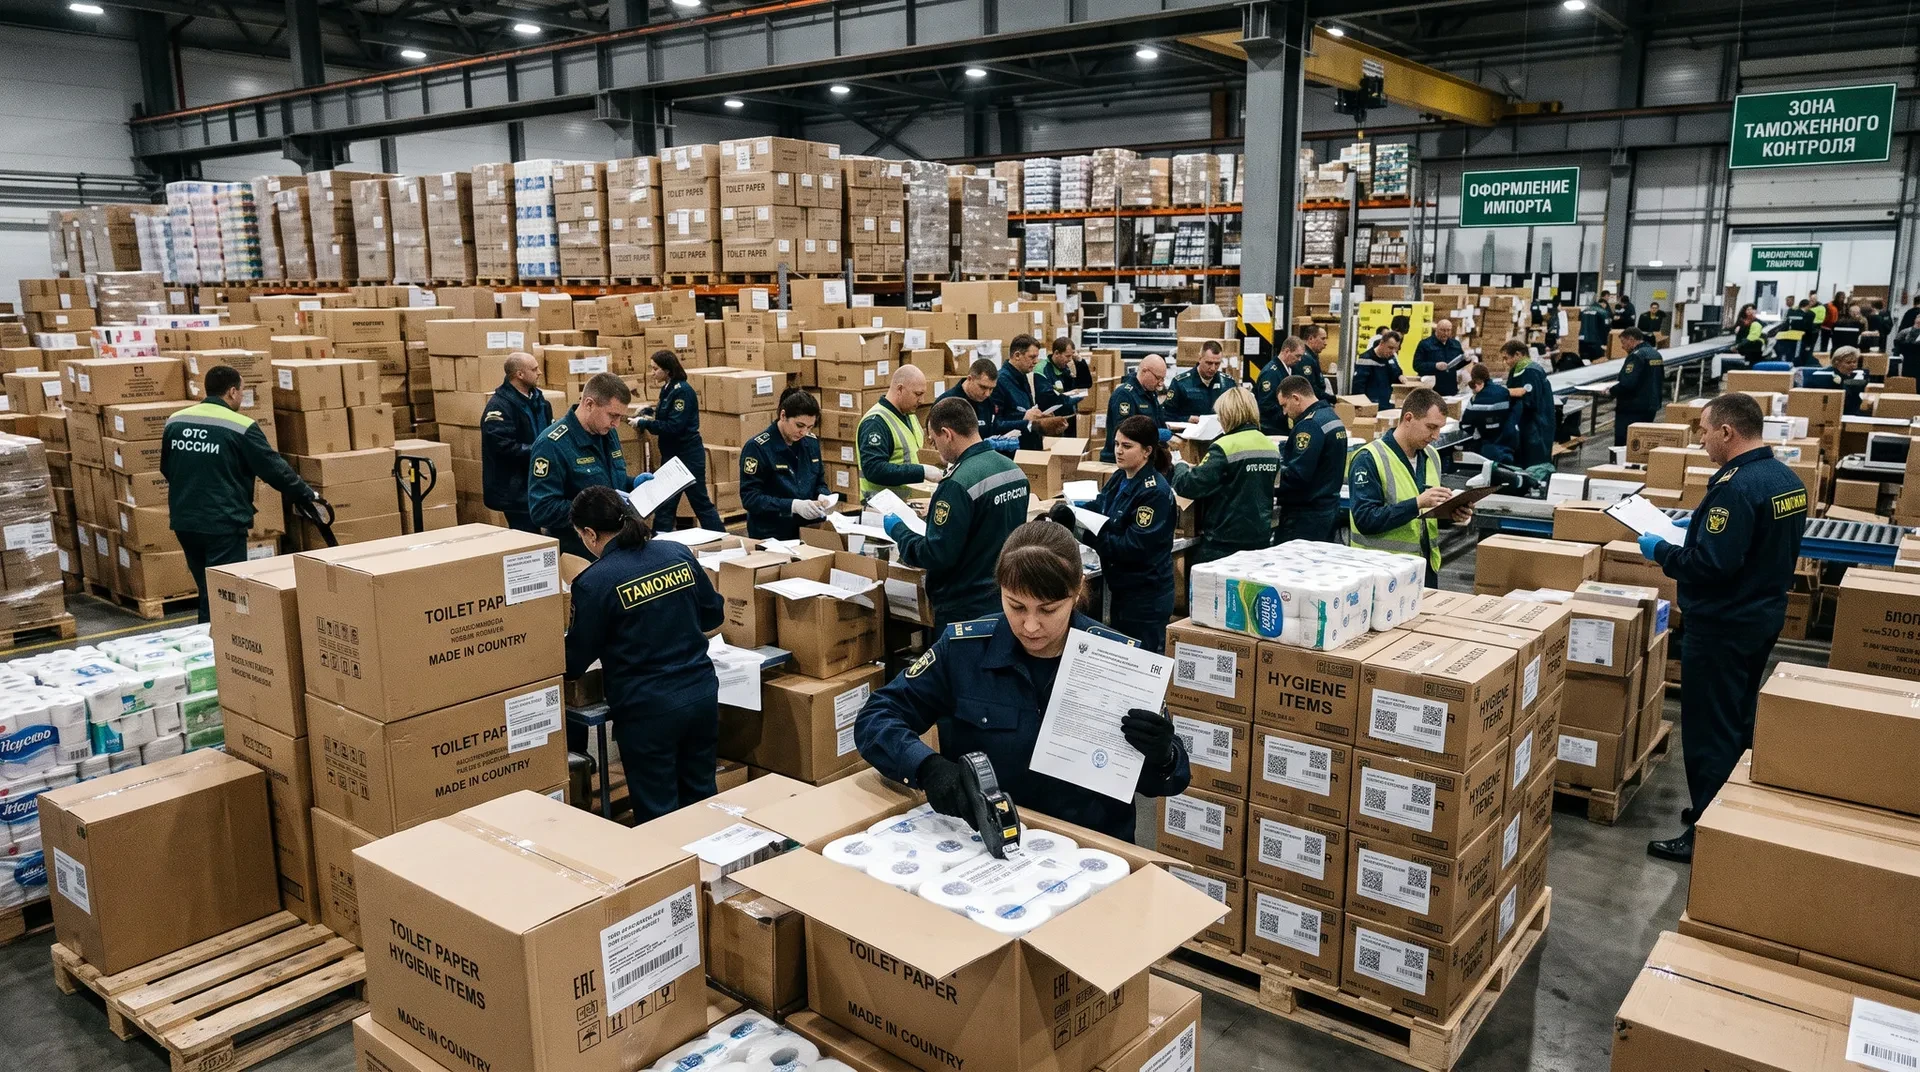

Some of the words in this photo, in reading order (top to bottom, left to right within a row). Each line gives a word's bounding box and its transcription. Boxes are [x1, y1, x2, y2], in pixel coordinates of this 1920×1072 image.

[1788, 98, 1836, 116] ЗОНА
[1744, 115, 1880, 139] ТАМОЖЕННОГО
[1762, 137, 1856, 157] КОНТРОЛЯ
[725, 184, 744, 194] TOILET
[745, 182, 766, 193] PAPER
[1469, 179, 1570, 198] ОФОРМЛЕНИЕ
[1483, 199, 1552, 215] ИМПОРТА
[687, 250, 707, 259] PAPER
[727, 249, 744, 259] TOILET
[747, 249, 767, 258] PAPER
[171, 439, 220, 455] РОССИИ
[182, 428, 208, 440] ФТС
[622, 567, 692, 603] ТАМОЖНЯ
[425, 601, 475, 624] TOILET
[479, 595, 524, 613] PAP
[429, 648, 461, 666] MADE
[464, 645, 475, 658] IN
[477, 632, 528, 654] COUNTRY
[1268, 671, 1347, 699] HYGIENE
[1279, 691, 1333, 715] ITEMS
[1479, 683, 1510, 718] HYGIENE
[432, 732, 480, 758] TOILET
[435, 779, 467, 798] MADE
[469, 775, 480, 787] IN
[481, 757, 531, 783] COUNTRY
[1469, 768, 1501, 806] HYGIENE
[390, 917, 432, 955] TOILET
[435, 943, 480, 982] PAPER
[389, 942, 442, 987] HYGIENE
[445, 974, 486, 1010] ITEMS
[847, 937, 899, 975] TOILET
[904, 964, 959, 1005] PAPER
[397, 1007, 427, 1037] MADE
[428, 1026, 438, 1045] IN
[440, 1035, 491, 1072] COUNTRY
[848, 1000, 882, 1030] MADE
[885, 1020, 898, 1038] IN
[901, 1029, 965, 1072] COUNTRY
